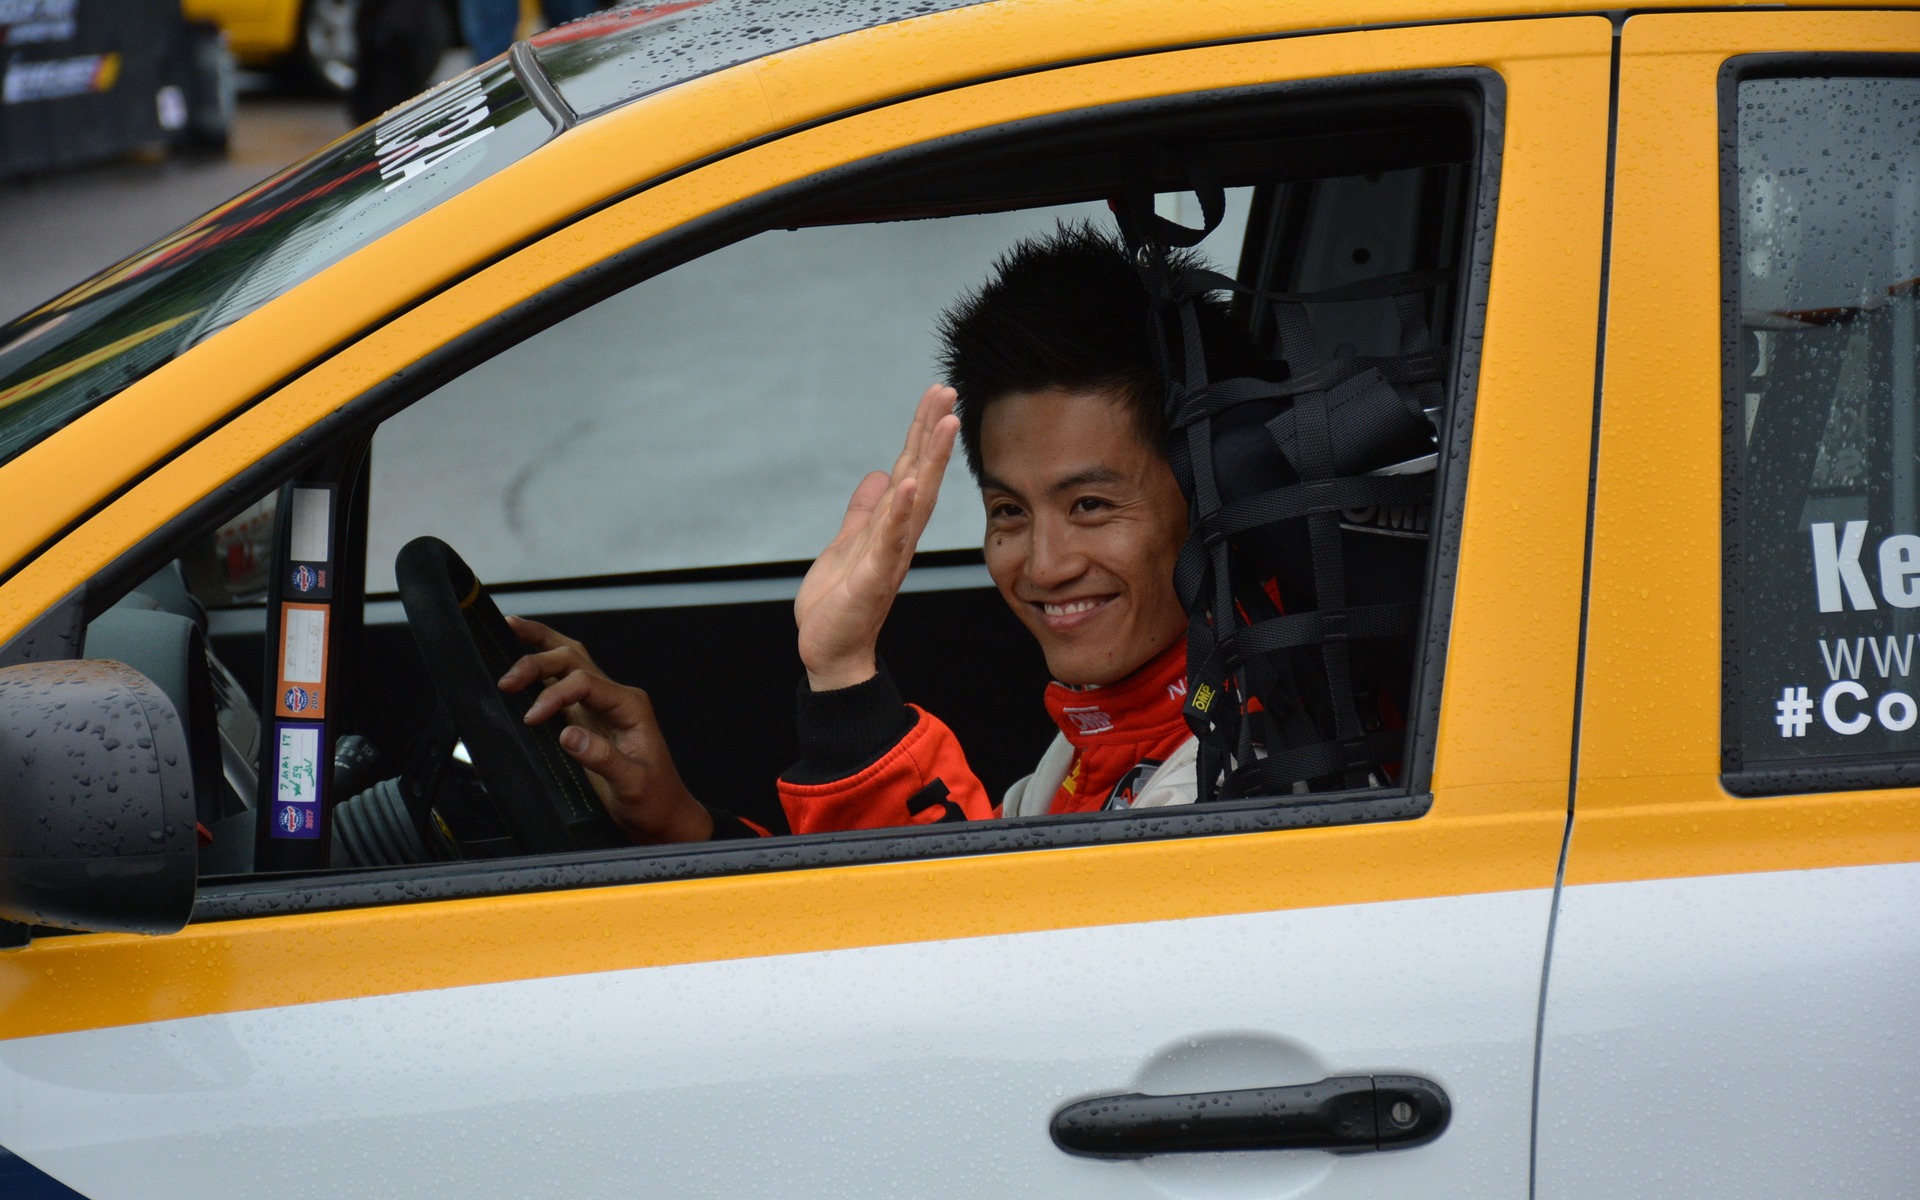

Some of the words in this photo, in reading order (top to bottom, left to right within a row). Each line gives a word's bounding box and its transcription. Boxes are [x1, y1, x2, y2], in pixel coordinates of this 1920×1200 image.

[1811, 519, 1920, 613] Ke
[310, 691, 319, 710] 2016
[1194, 684, 1213, 711] OMP
[1776, 680, 1919, 738] #Co
